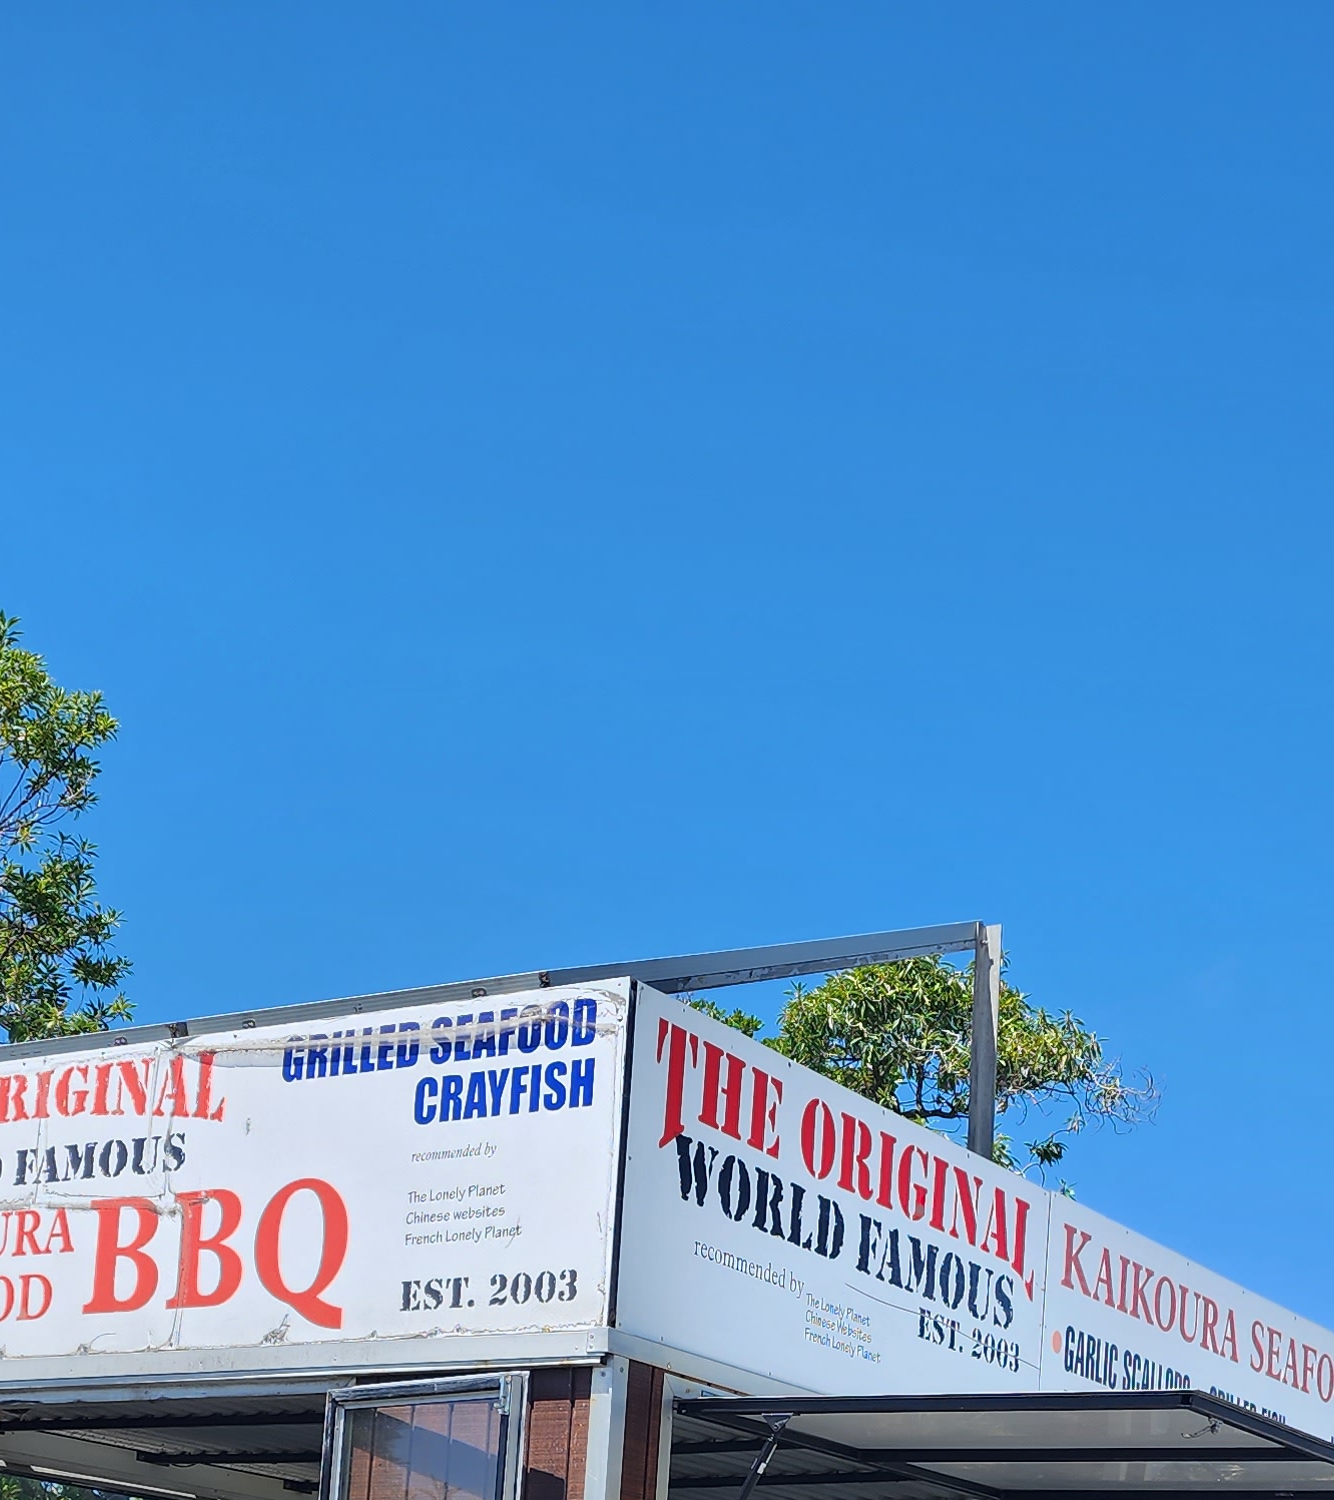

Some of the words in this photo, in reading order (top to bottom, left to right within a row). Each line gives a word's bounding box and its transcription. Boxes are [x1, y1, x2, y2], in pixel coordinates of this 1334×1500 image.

[281, 1021, 420, 1083] GRILLED
[430, 998, 598, 1064] SEAFOOD
[413, 1058, 595, 1125] CRAYFISH
[13, 1132, 186, 1186] FAMOUS
[411, 1143, 482, 1162] recommended
[484, 1142, 497, 1158] by
[657, 1017, 783, 1159] THE
[800, 1098, 1034, 1302] ORIGINAL
[405, 1210, 450, 1225] Chinese
[453, 1206, 505, 1220] websites
[407, 1191, 427, 1203] The
[429, 1186, 466, 1202] Lonely
[468, 1183, 506, 1198] Planet
[82, 1177, 349, 1330] BBQ
[405, 1231, 442, 1246] French
[445, 1228, 482, 1243] Lonely
[485, 1225, 522, 1239] Planet
[675, 1134, 845, 1259] WORLD
[855, 1213, 1014, 1330] FAMOUS
[399, 1277, 475, 1312] EST.
[489, 1269, 578, 1306] 2003
[694, 1240, 786, 1289] recommended
[789, 1271, 804, 1298] by
[1062, 1223, 1241, 1366] KAIKOURA
[805, 1310, 835, 1331] Chinese
[836, 1320, 872, 1343] Websites
[806, 1293, 819, 1309] The
[821, 1298, 845, 1320] Lonely
[846, 1307, 870, 1327] Planet
[804, 1328, 830, 1347] French
[832, 1335, 857, 1358] Lonely
[918, 1307, 964, 1353] EST.
[971, 1328, 1020, 1373] 2003
[1064, 1325, 1118, 1390] GARLIC
